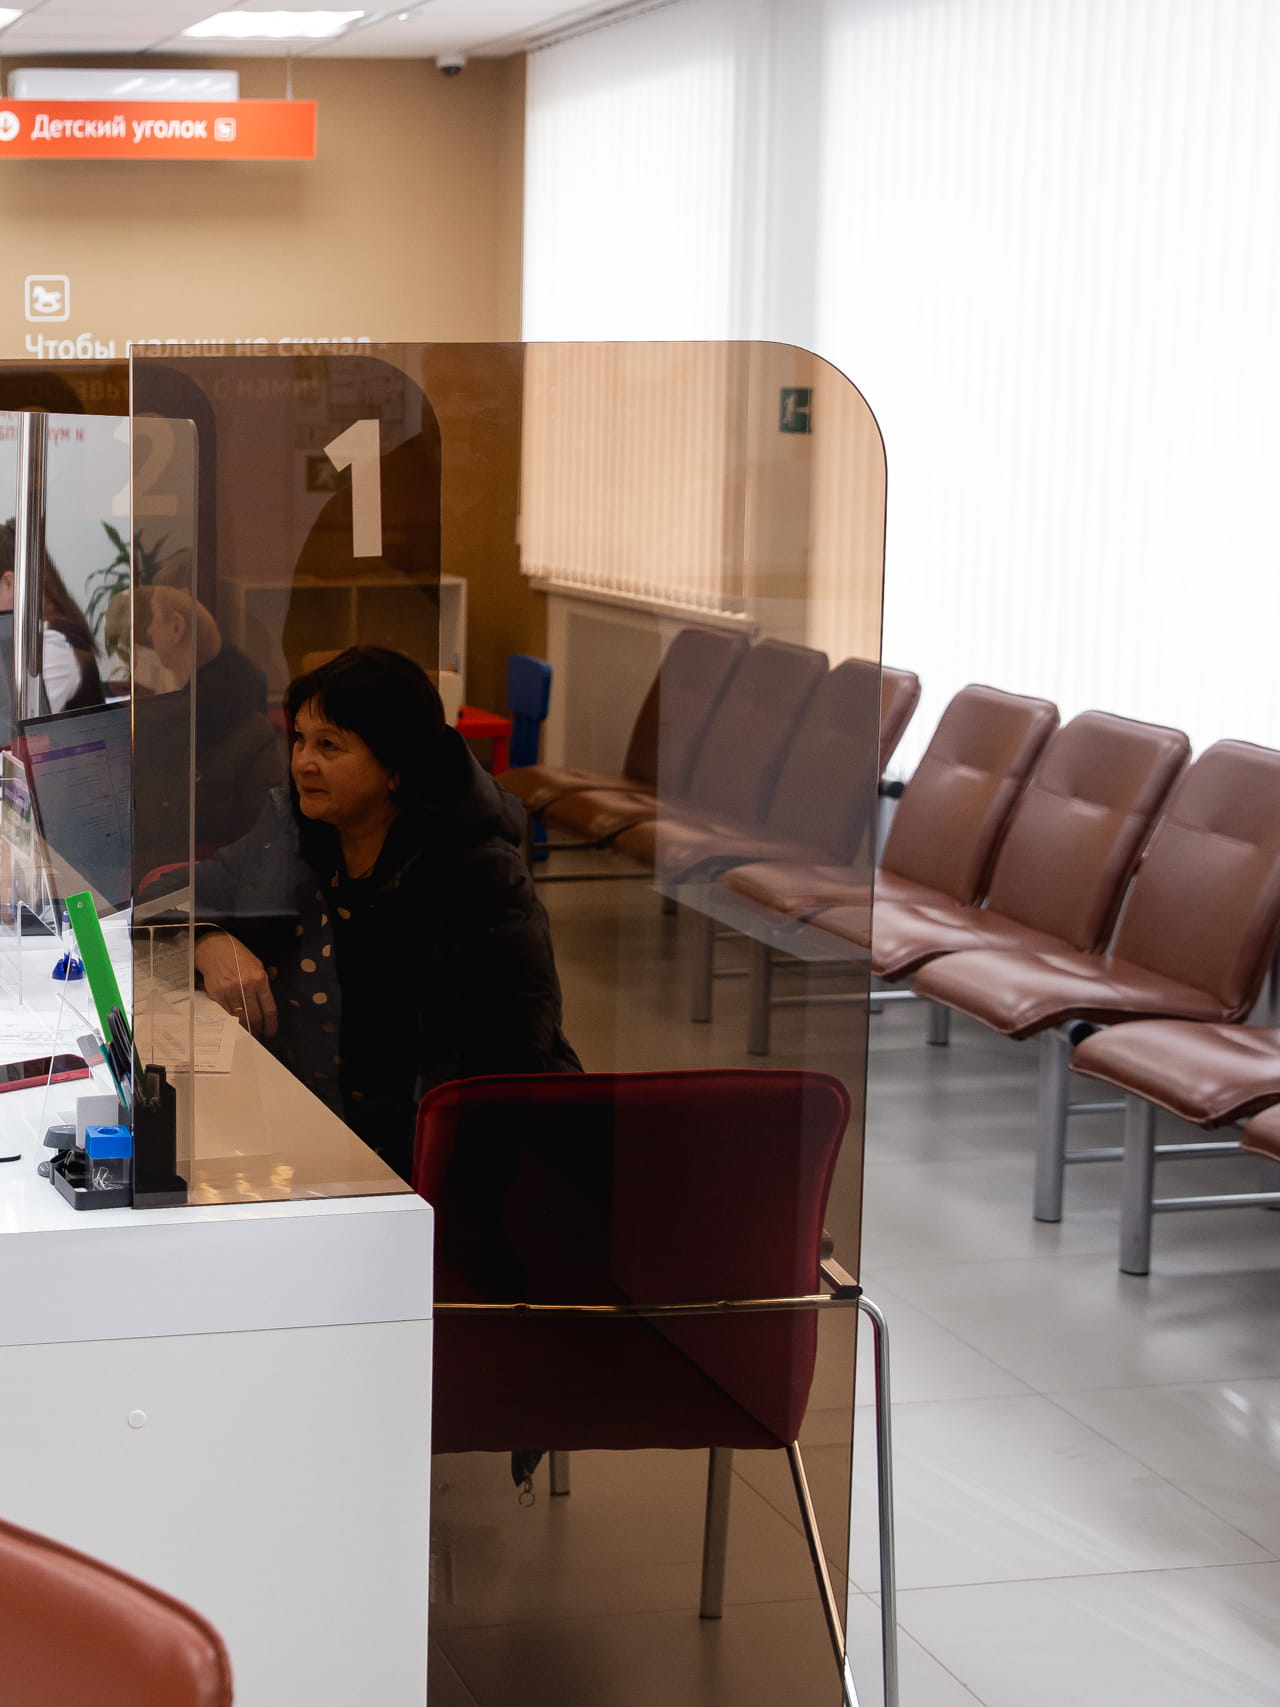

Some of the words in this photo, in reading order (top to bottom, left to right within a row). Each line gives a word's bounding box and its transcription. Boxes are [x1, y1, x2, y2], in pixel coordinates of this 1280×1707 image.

[31, 114, 126, 141] Детский
[132, 118, 208, 143] уголок
[25, 333, 114, 359] Чтобы
[112, 412, 177, 516] 2
[323, 419, 382, 557] 1
